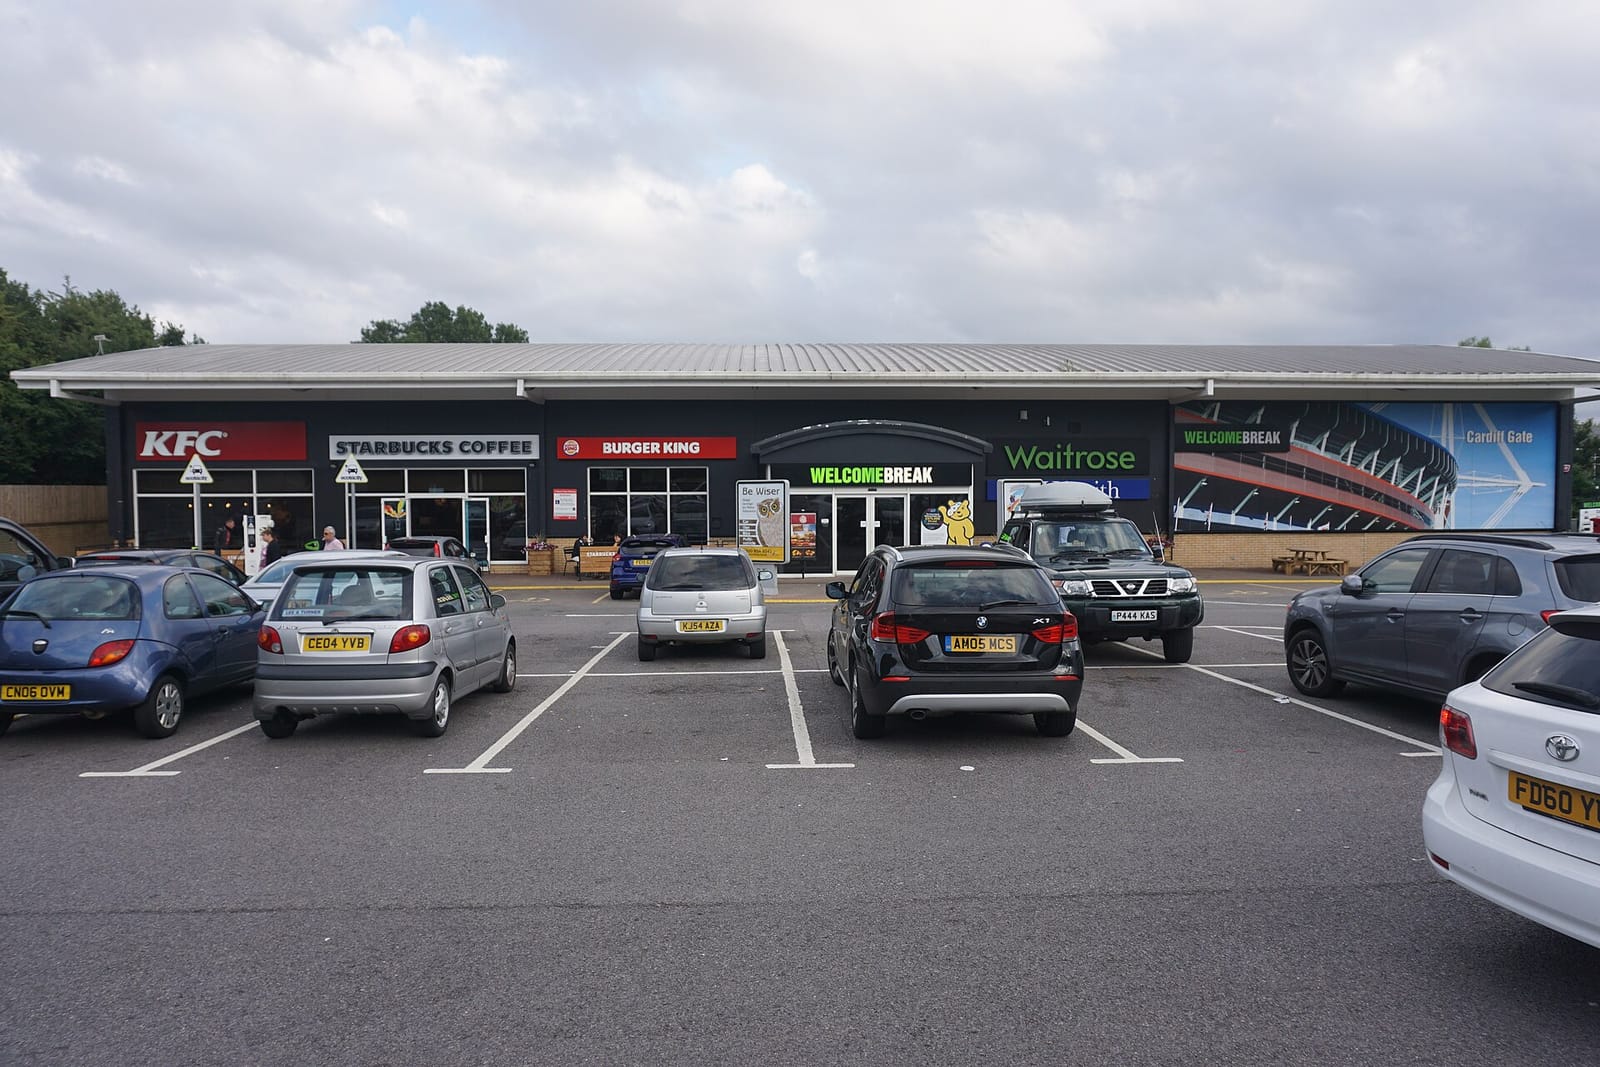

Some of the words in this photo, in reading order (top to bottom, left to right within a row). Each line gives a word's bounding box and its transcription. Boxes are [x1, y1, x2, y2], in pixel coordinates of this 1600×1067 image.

[1184, 431, 1281, 444] WELCOMEBREAK
[1466, 430, 1504, 443] Cardiff
[1507, 430, 1534, 443] Gate
[140, 431, 223, 456] KFC
[336, 441, 454, 455] STARBUCKS
[459, 441, 533, 454] COFFEE
[602, 442, 661, 454] BURGER
[663, 442, 700, 454] KING
[1004, 443, 1136, 470] Waitrose
[810, 467, 933, 484] WELCOMEBREAK
[742, 487, 753, 496] Be
[755, 487, 780, 496] Wiser
[1116, 612, 1137, 620] P444
[1140, 611, 1156, 619] KAS
[682, 621, 703, 630] KJ54
[704, 621, 720, 630] AZA
[308, 637, 338, 649] CE04
[341, 637, 365, 649] YVB
[953, 637, 987, 650] AM05
[989, 637, 1014, 650] MCS
[6, 686, 37, 698] CN06
[40, 686, 65, 698] OVM
[1515, 777, 1573, 815] FD60
[1581, 795, 1600, 824] Y
